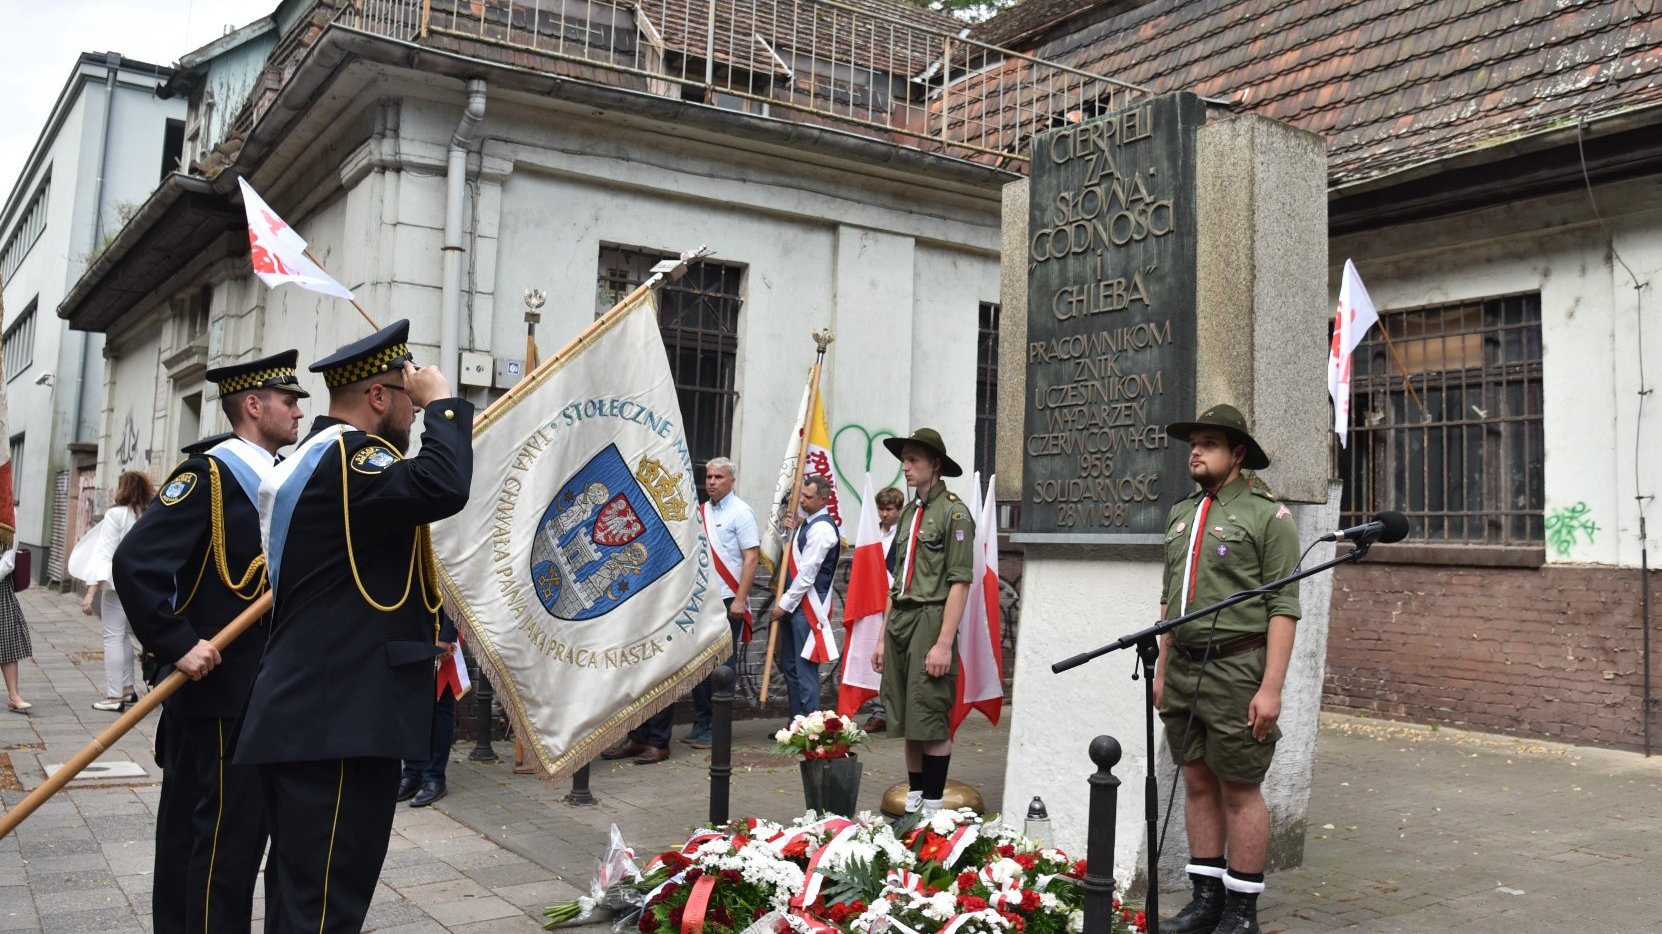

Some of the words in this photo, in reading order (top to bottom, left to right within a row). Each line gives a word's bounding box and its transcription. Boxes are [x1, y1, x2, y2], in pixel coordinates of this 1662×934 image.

[1050, 105, 1153, 164] CIERPIELI
[1084, 149, 1121, 188] ZA
[1096, 249, 1103, 280] i
[1029, 320, 1173, 365] PRACOWNIKOM
[1074, 354, 1124, 382] ZNTK
[1035, 370, 1164, 411] UCZESTNIKOM
[1046, 397, 1147, 433] WYDARZEŃ
[1027, 424, 1169, 457] CZERWCOWYCH
[1077, 453, 1115, 478] 1956
[1032, 473, 1161, 503] SOLIDARNOŚĆ
[562, 399, 673, 439] STOŁECZNE
[675, 532, 709, 635] POZNAŃ
[493, 476, 522, 563] CHWAŁA
[545, 639, 599, 669] PRACA
[604, 639, 665, 669] NASZA
